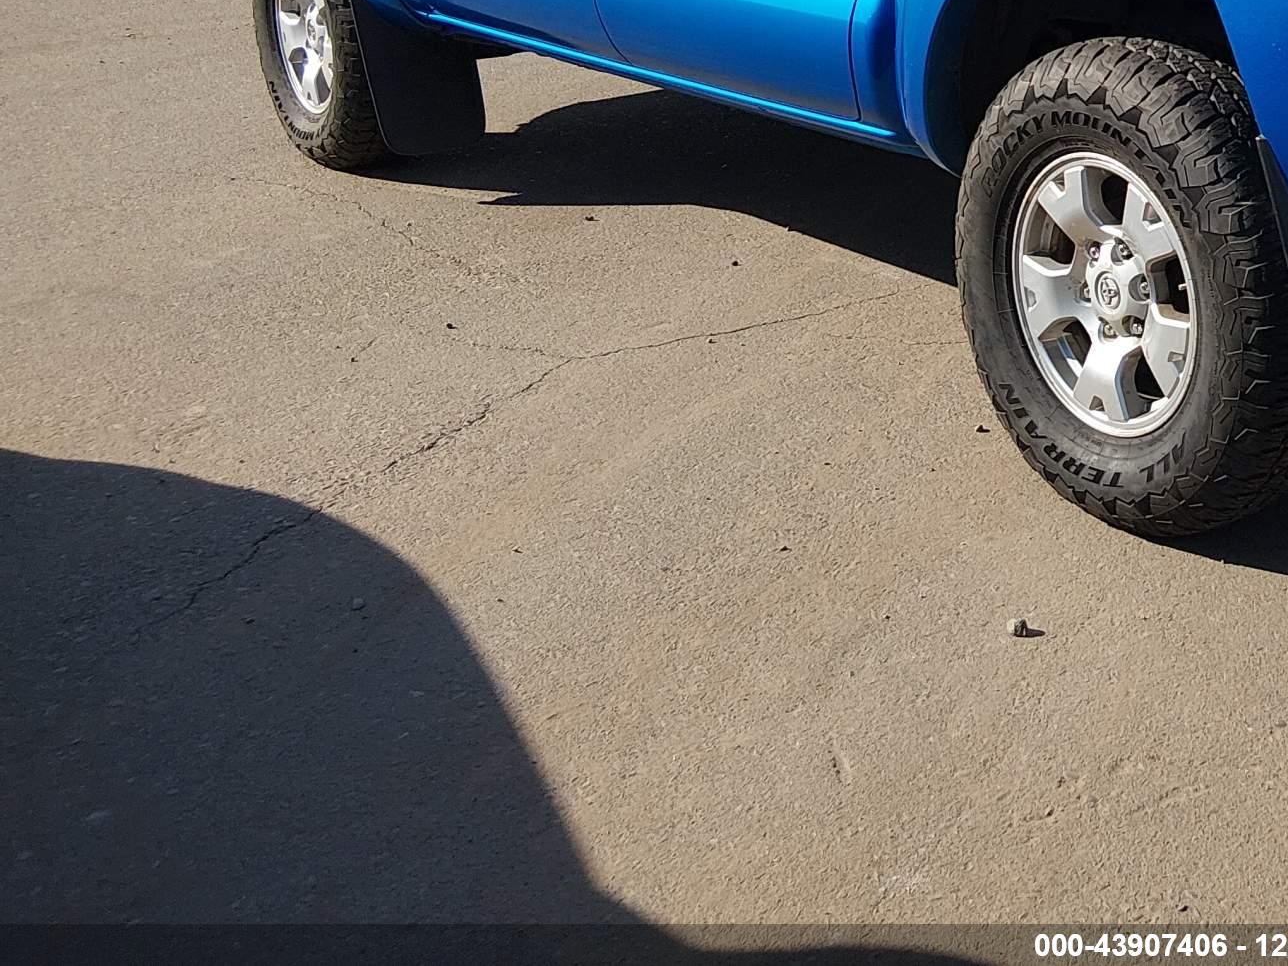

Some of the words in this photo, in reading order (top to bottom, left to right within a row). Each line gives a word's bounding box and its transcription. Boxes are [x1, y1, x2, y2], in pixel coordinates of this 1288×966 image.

[981, 113, 1047, 198] ROCKY
[998, 384, 1125, 489] TERRAIN
[1139, 431, 1187, 484] ALL
